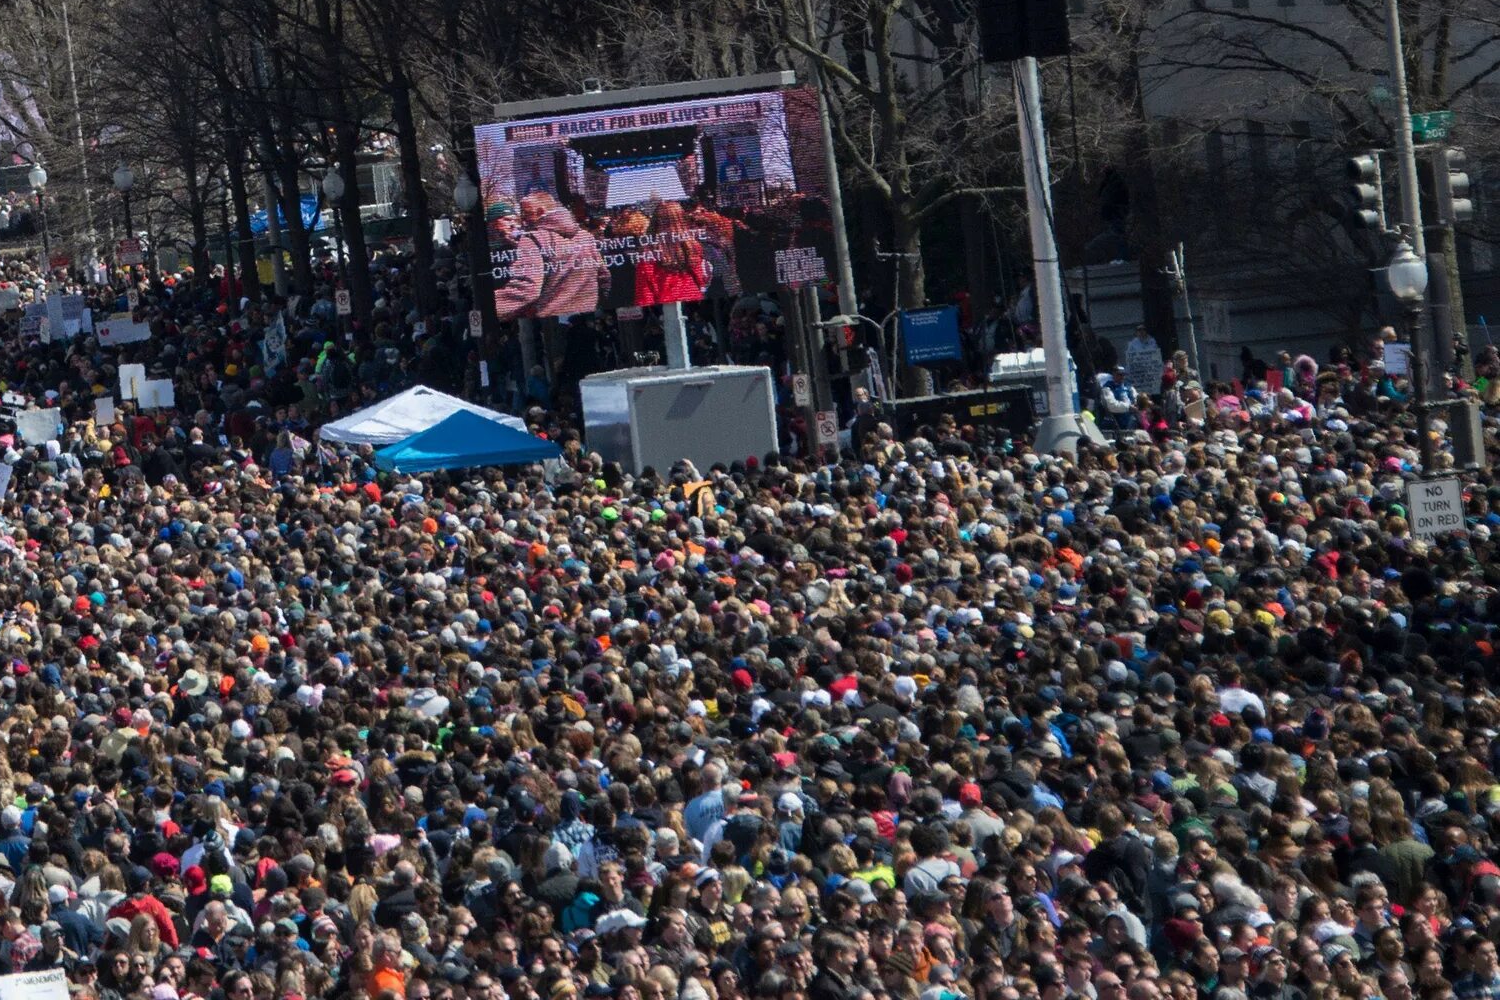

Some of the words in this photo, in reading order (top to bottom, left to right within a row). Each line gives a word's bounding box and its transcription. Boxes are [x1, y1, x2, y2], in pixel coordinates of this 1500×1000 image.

[558, 118, 605, 136] MARCH
[610, 114, 637, 130] FOR
[640, 110, 668, 126] OUR
[672, 106, 710, 123] LIVES
[490, 249, 523, 263] HATE
[594, 236, 636, 251] DRIVE
[639, 231, 668, 246] OUT
[671, 228, 711, 242] HATE.
[604, 254, 626, 267] DO
[1425, 485, 1443, 498] NO
[1422, 500, 1451, 513] TURN
[1418, 517, 1433, 528] ON
[1438, 514, 1459, 526] RED
